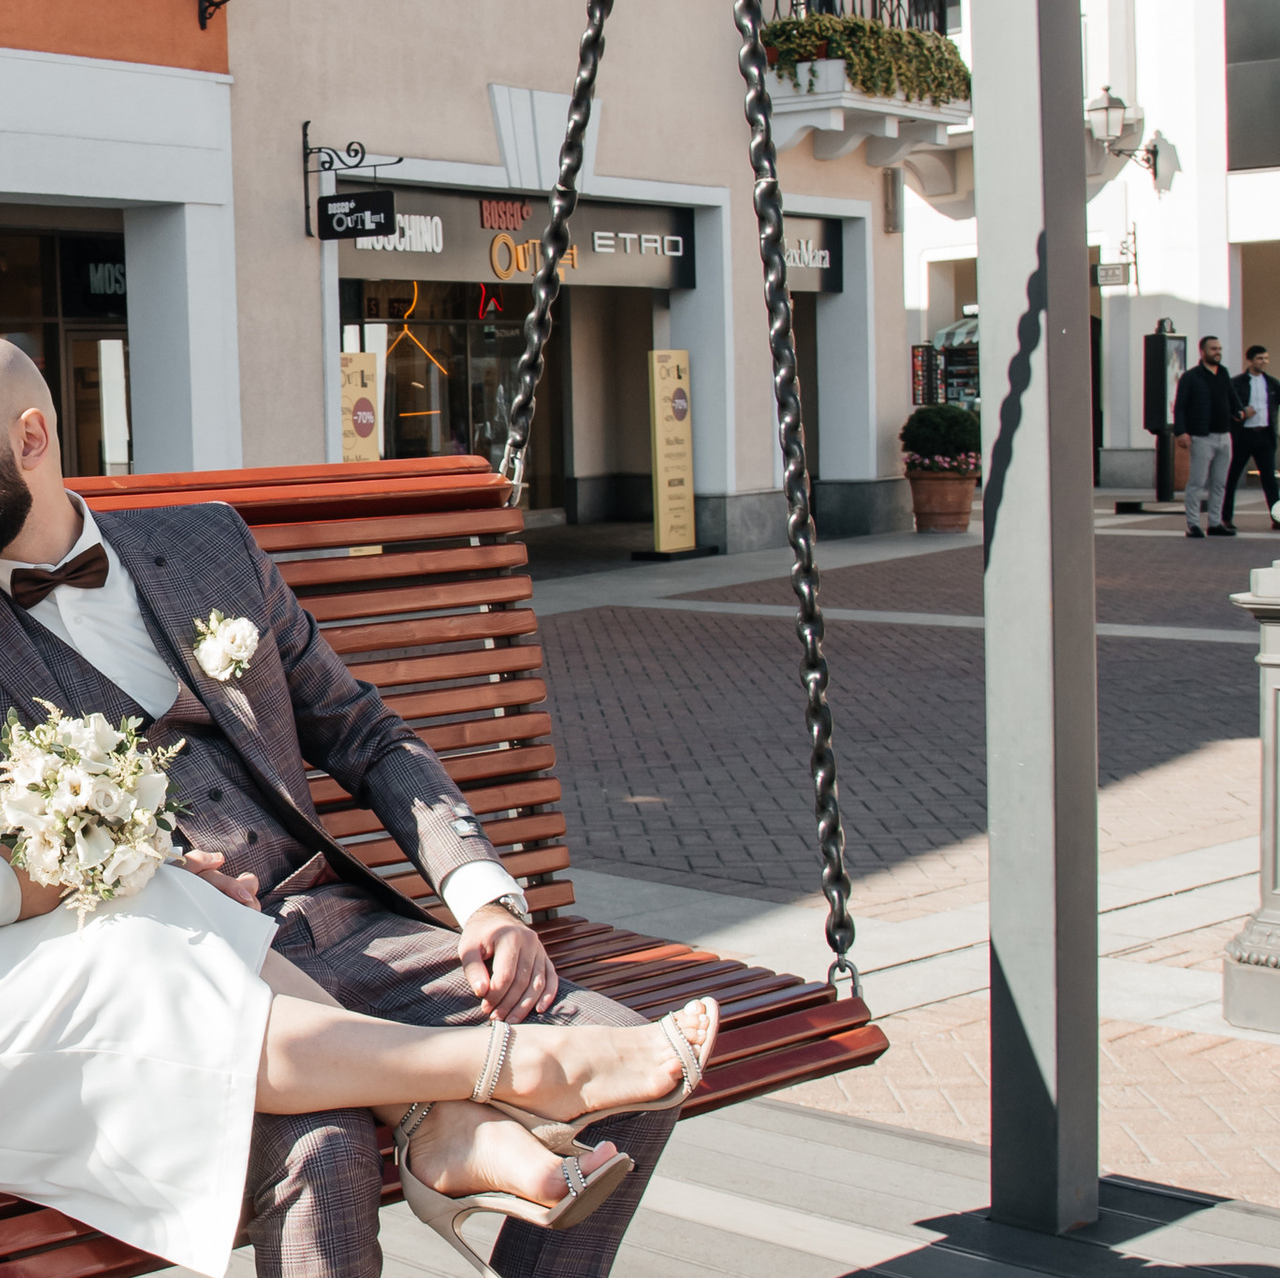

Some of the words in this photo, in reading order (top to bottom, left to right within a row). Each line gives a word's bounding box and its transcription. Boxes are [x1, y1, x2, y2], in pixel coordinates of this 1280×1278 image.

[481, 200, 523, 231] BOSCO
[783, 238, 830, 268] axMara
[353, 411, 375, 424] -70%
